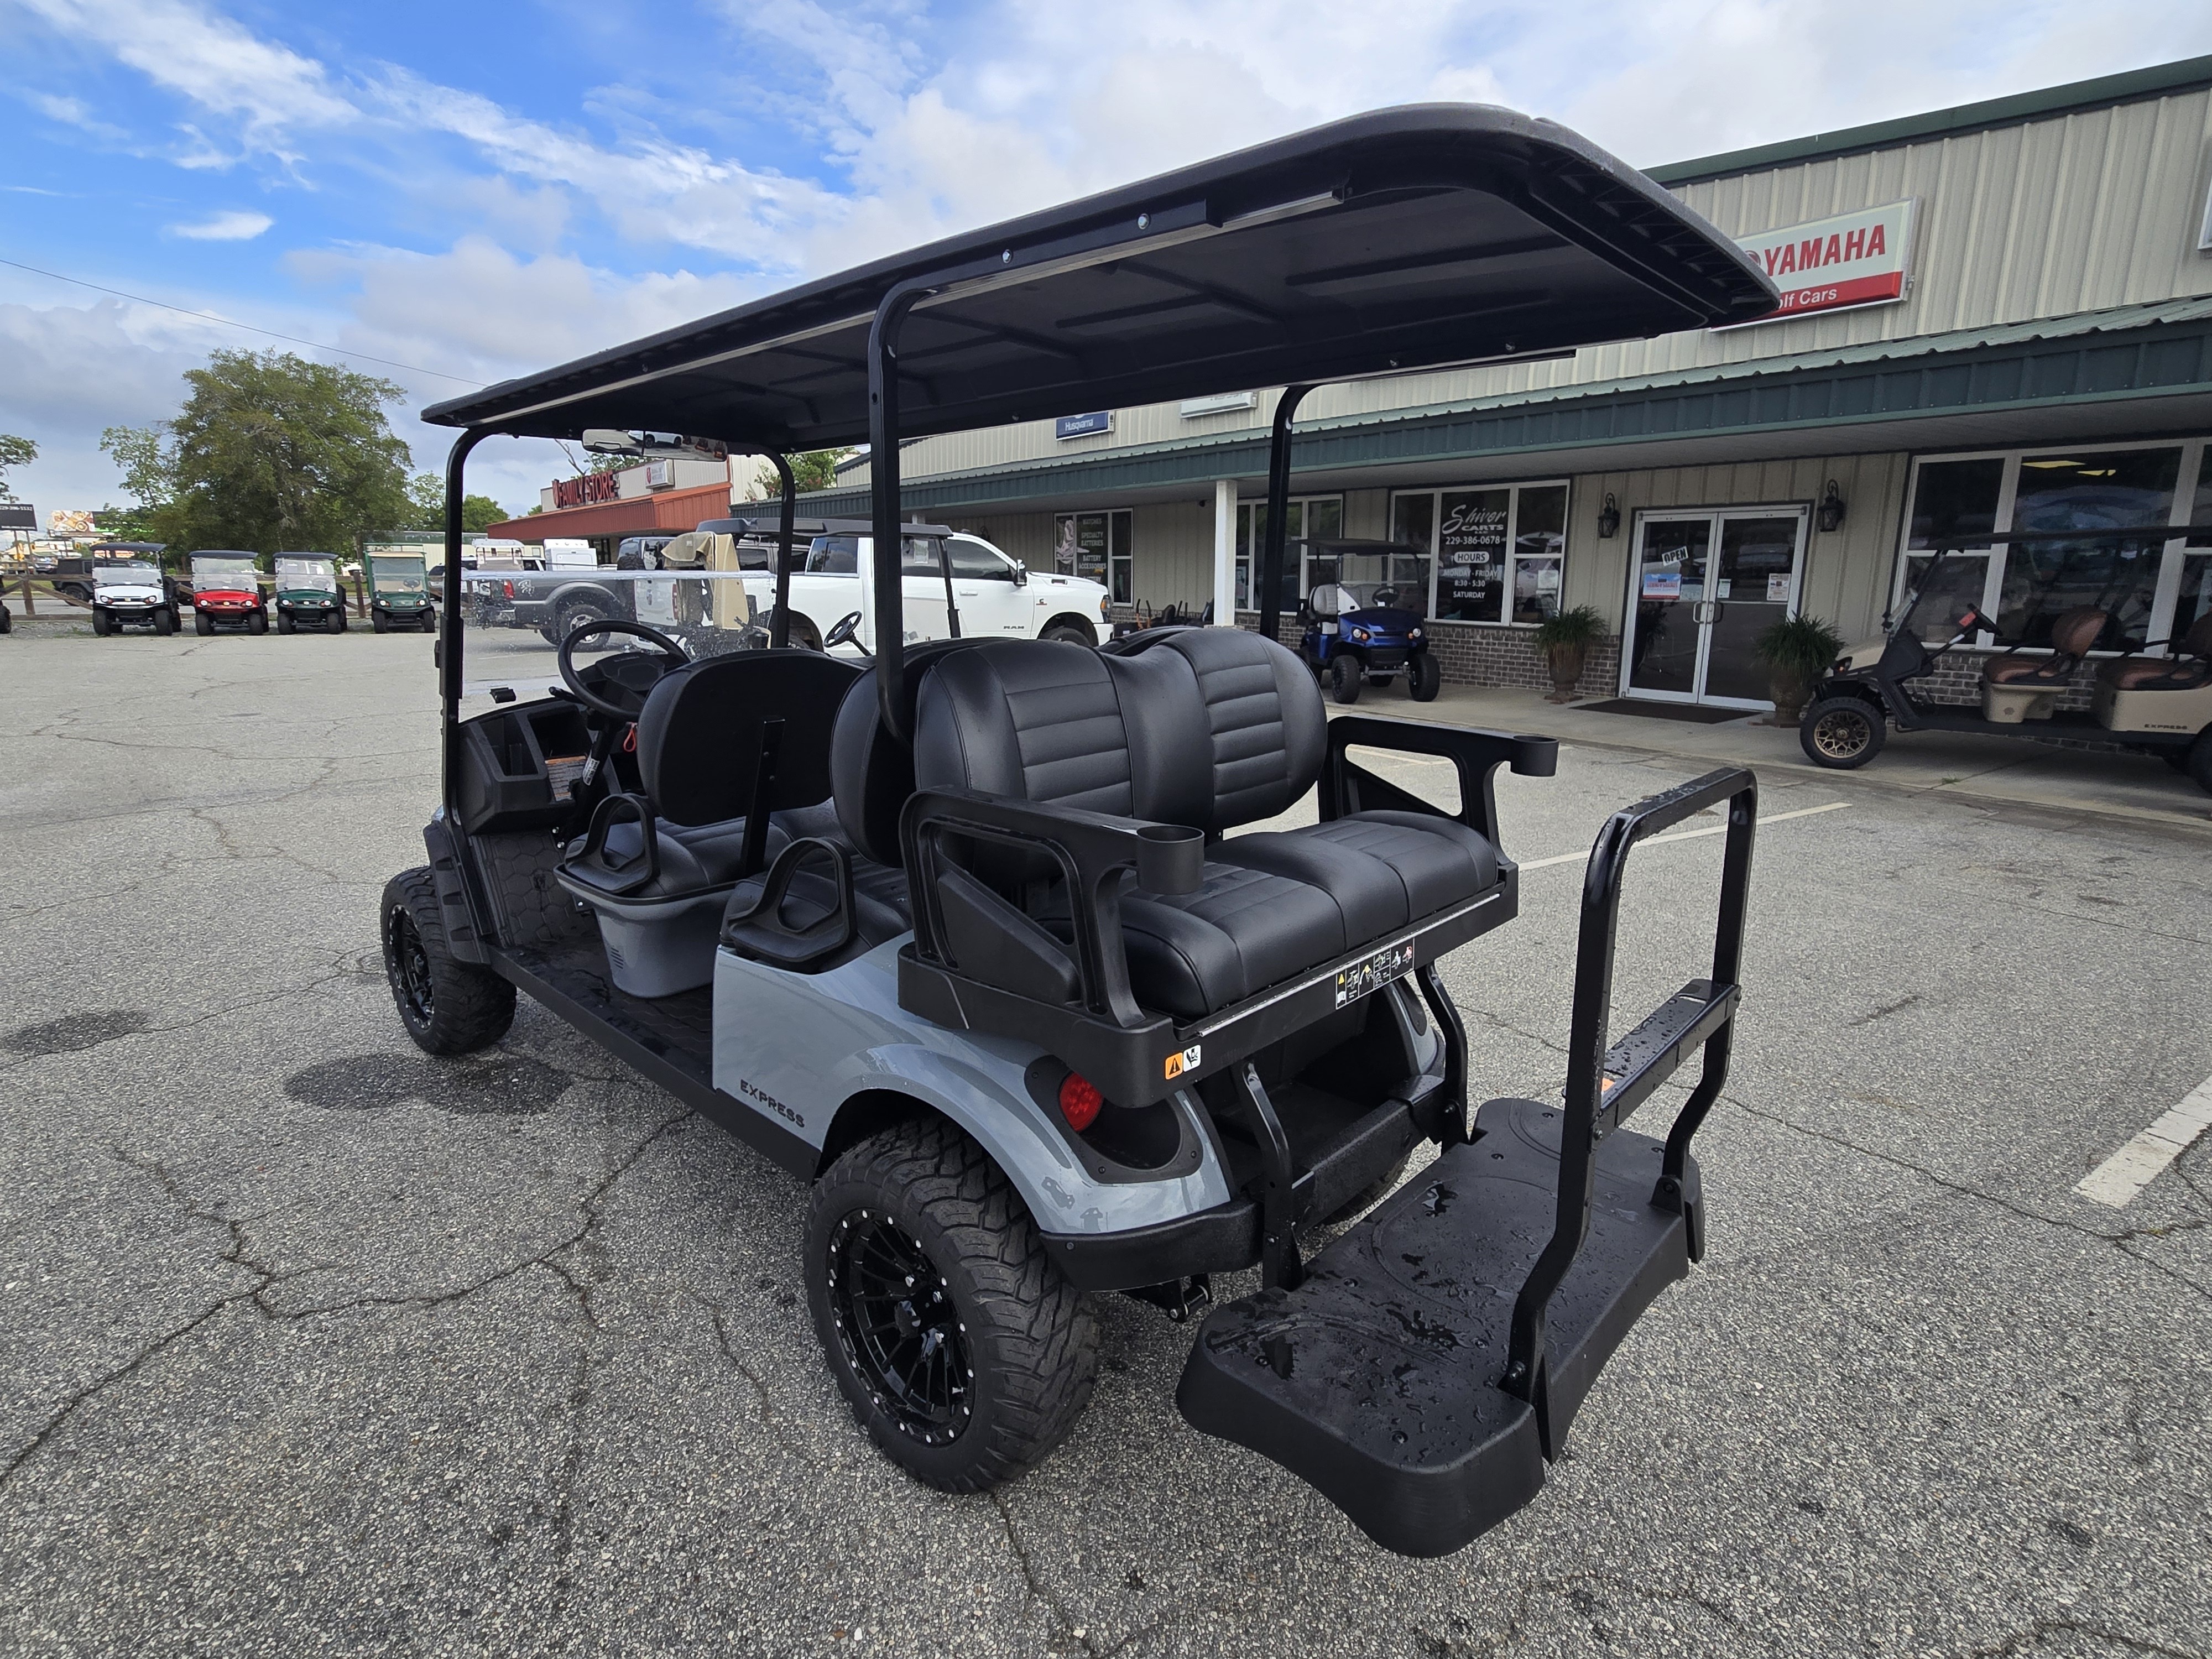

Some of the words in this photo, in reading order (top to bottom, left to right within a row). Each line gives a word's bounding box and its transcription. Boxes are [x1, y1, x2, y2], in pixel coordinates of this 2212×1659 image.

[1765, 224, 1886, 276] YAMAHA
[1799, 289, 1837, 305] Cars
[559, 476, 585, 509] FAMILY
[585, 470, 615, 502] STORE
[1445, 536, 1500, 545] 229-386-0678
[1664, 549, 1687, 564] OPEN
[740, 1079, 805, 1128] EXPRESS
